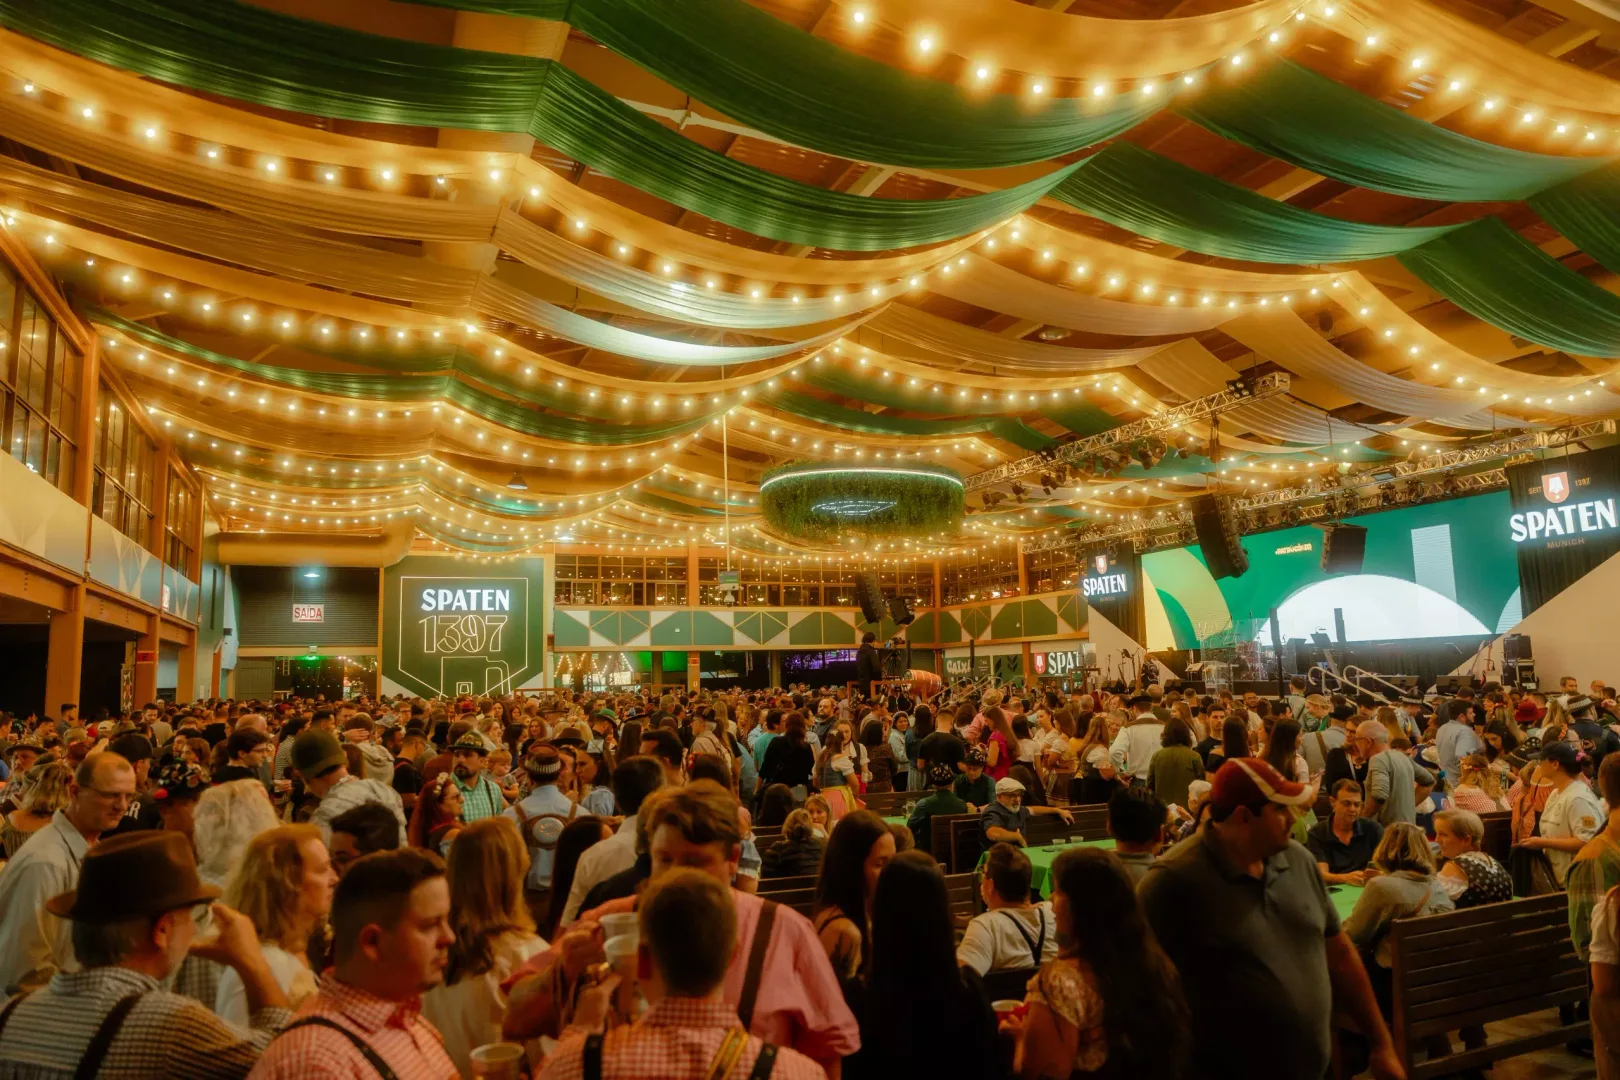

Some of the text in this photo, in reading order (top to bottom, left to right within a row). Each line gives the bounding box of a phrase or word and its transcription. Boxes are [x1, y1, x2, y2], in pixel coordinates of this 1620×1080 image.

[1510, 499, 1618, 542] SPATEN
[1547, 538, 1585, 548] MUNICH
[1083, 574, 1127, 596] SPATEN
[421, 588, 510, 611] SPATEN
[294, 605, 323, 618] SAÍDA
[419, 615, 508, 653] 1397
